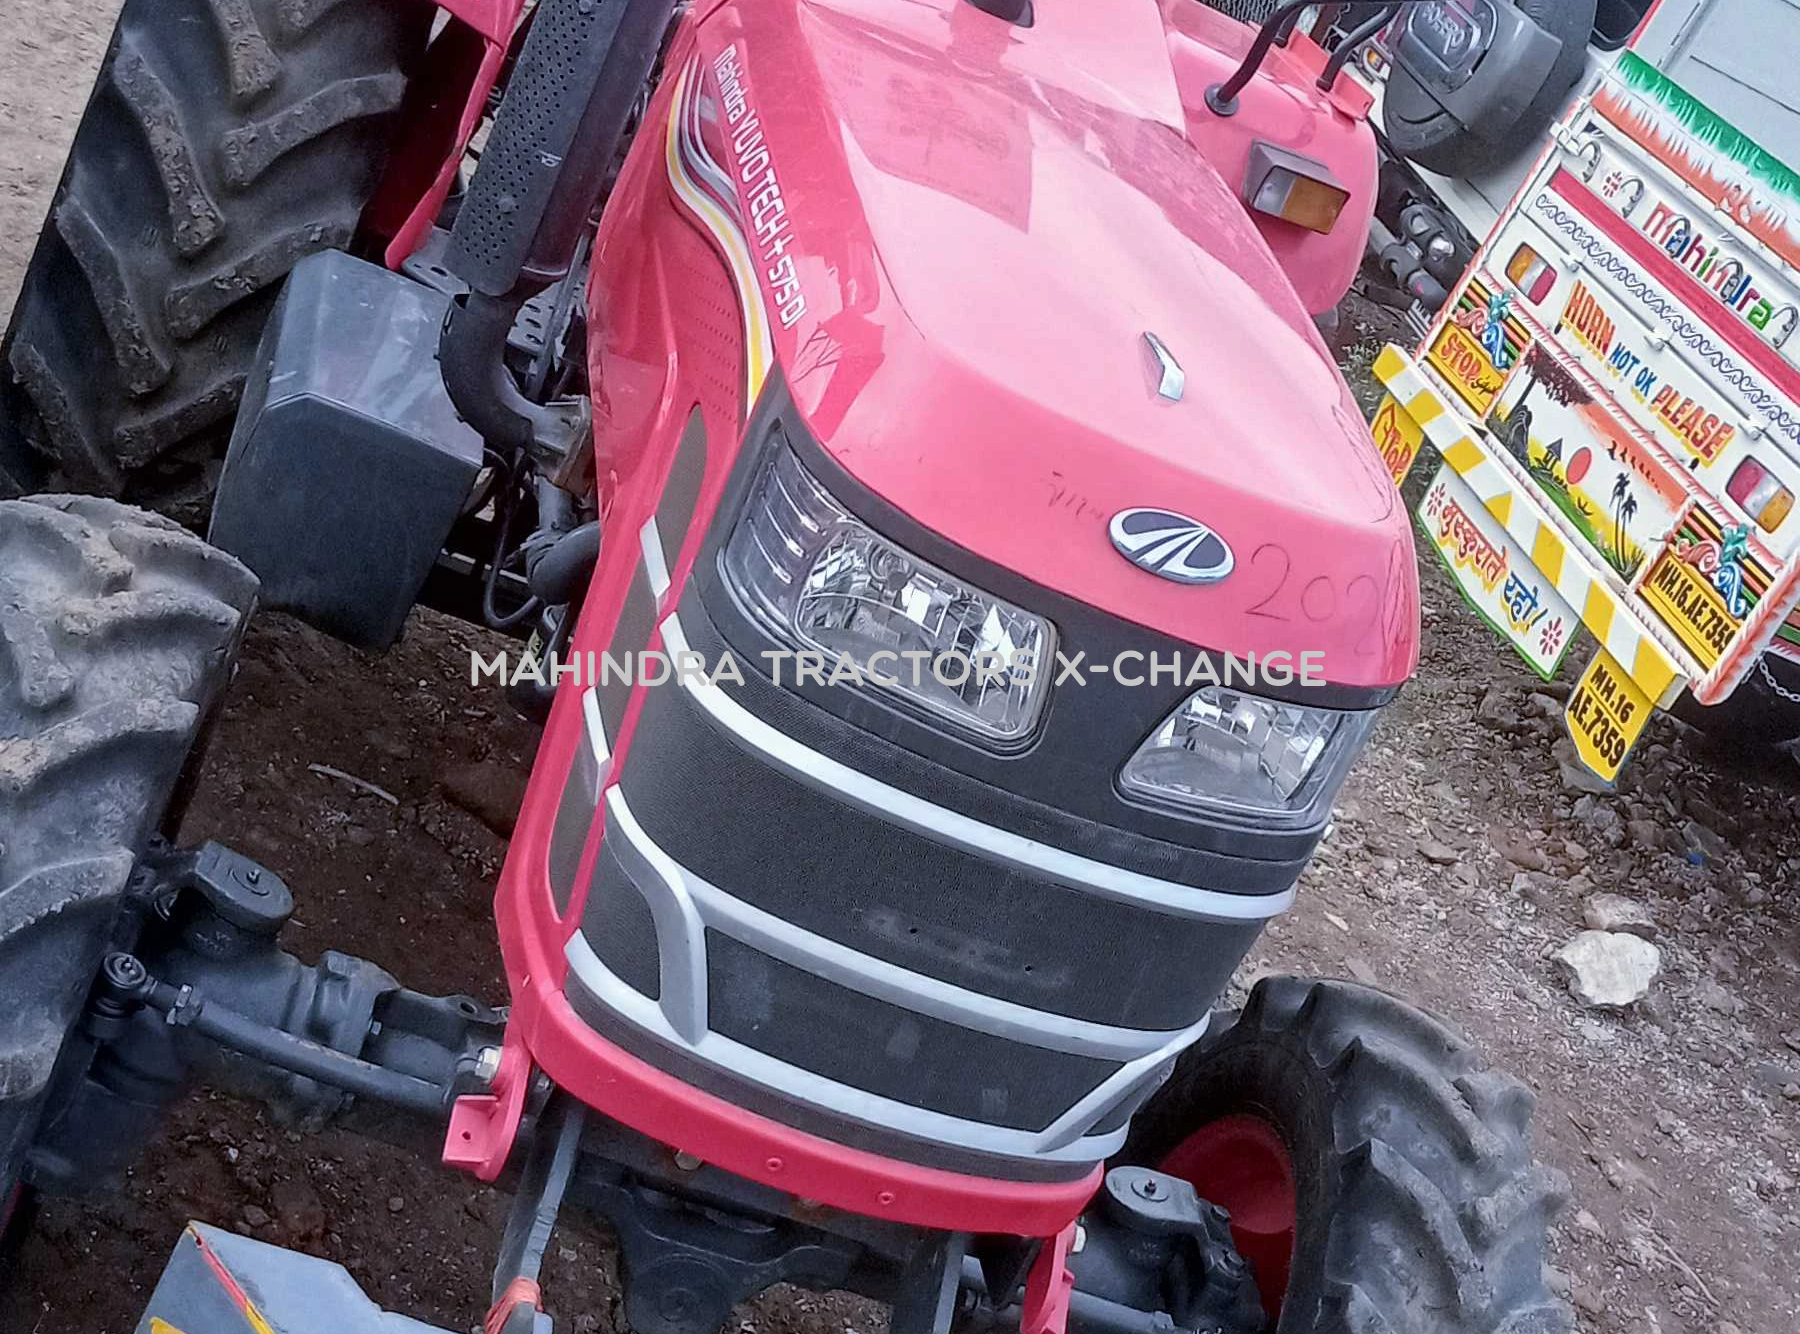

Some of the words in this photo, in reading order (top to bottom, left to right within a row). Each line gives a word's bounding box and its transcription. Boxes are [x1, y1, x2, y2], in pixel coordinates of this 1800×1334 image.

[730, 107, 772, 185] YUVO
[746, 163, 790, 248] TECH
[763, 234, 795, 264] +
[767, 253, 804, 308] 575
[1440, 332, 1482, 385] STOP
[1563, 278, 1616, 357] HORN
[1609, 341, 1641, 377] NOT
[1633, 365, 1658, 398] OK
[1650, 383, 1736, 461] PLEASE
[1440, 496, 1510, 585] मुस्कुराते
[1567, 685, 1627, 769] AE.7359
[1589, 663, 1636, 725] MH.16
